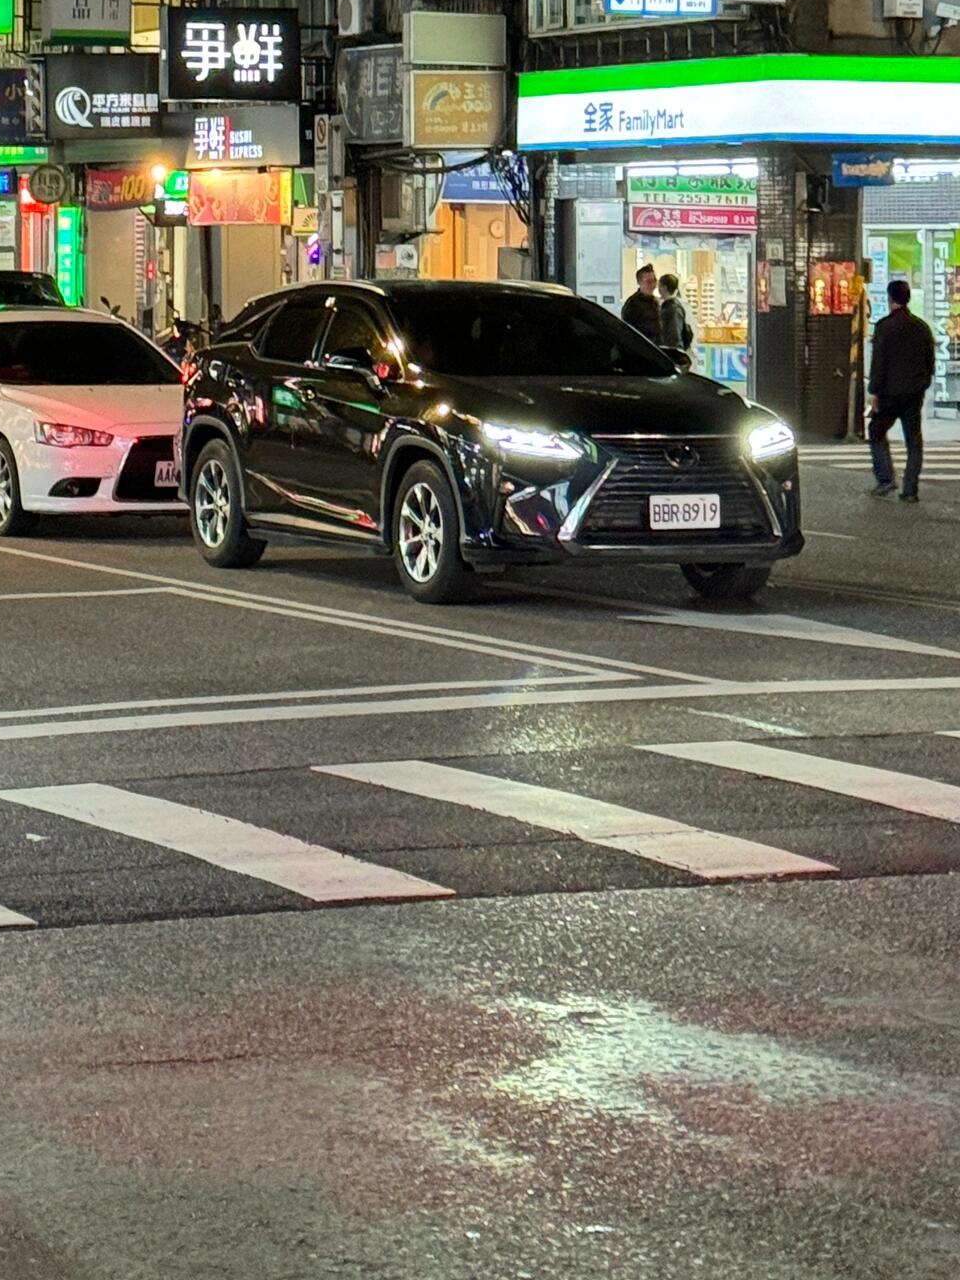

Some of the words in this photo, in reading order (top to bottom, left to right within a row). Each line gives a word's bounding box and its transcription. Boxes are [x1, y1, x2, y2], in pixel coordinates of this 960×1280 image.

[583, 101, 614, 133] 全家
[618, 108, 685, 136] FamilyMart
[229, 130, 252, 144] SUSHI
[229, 144, 263, 160] EXPRESS
